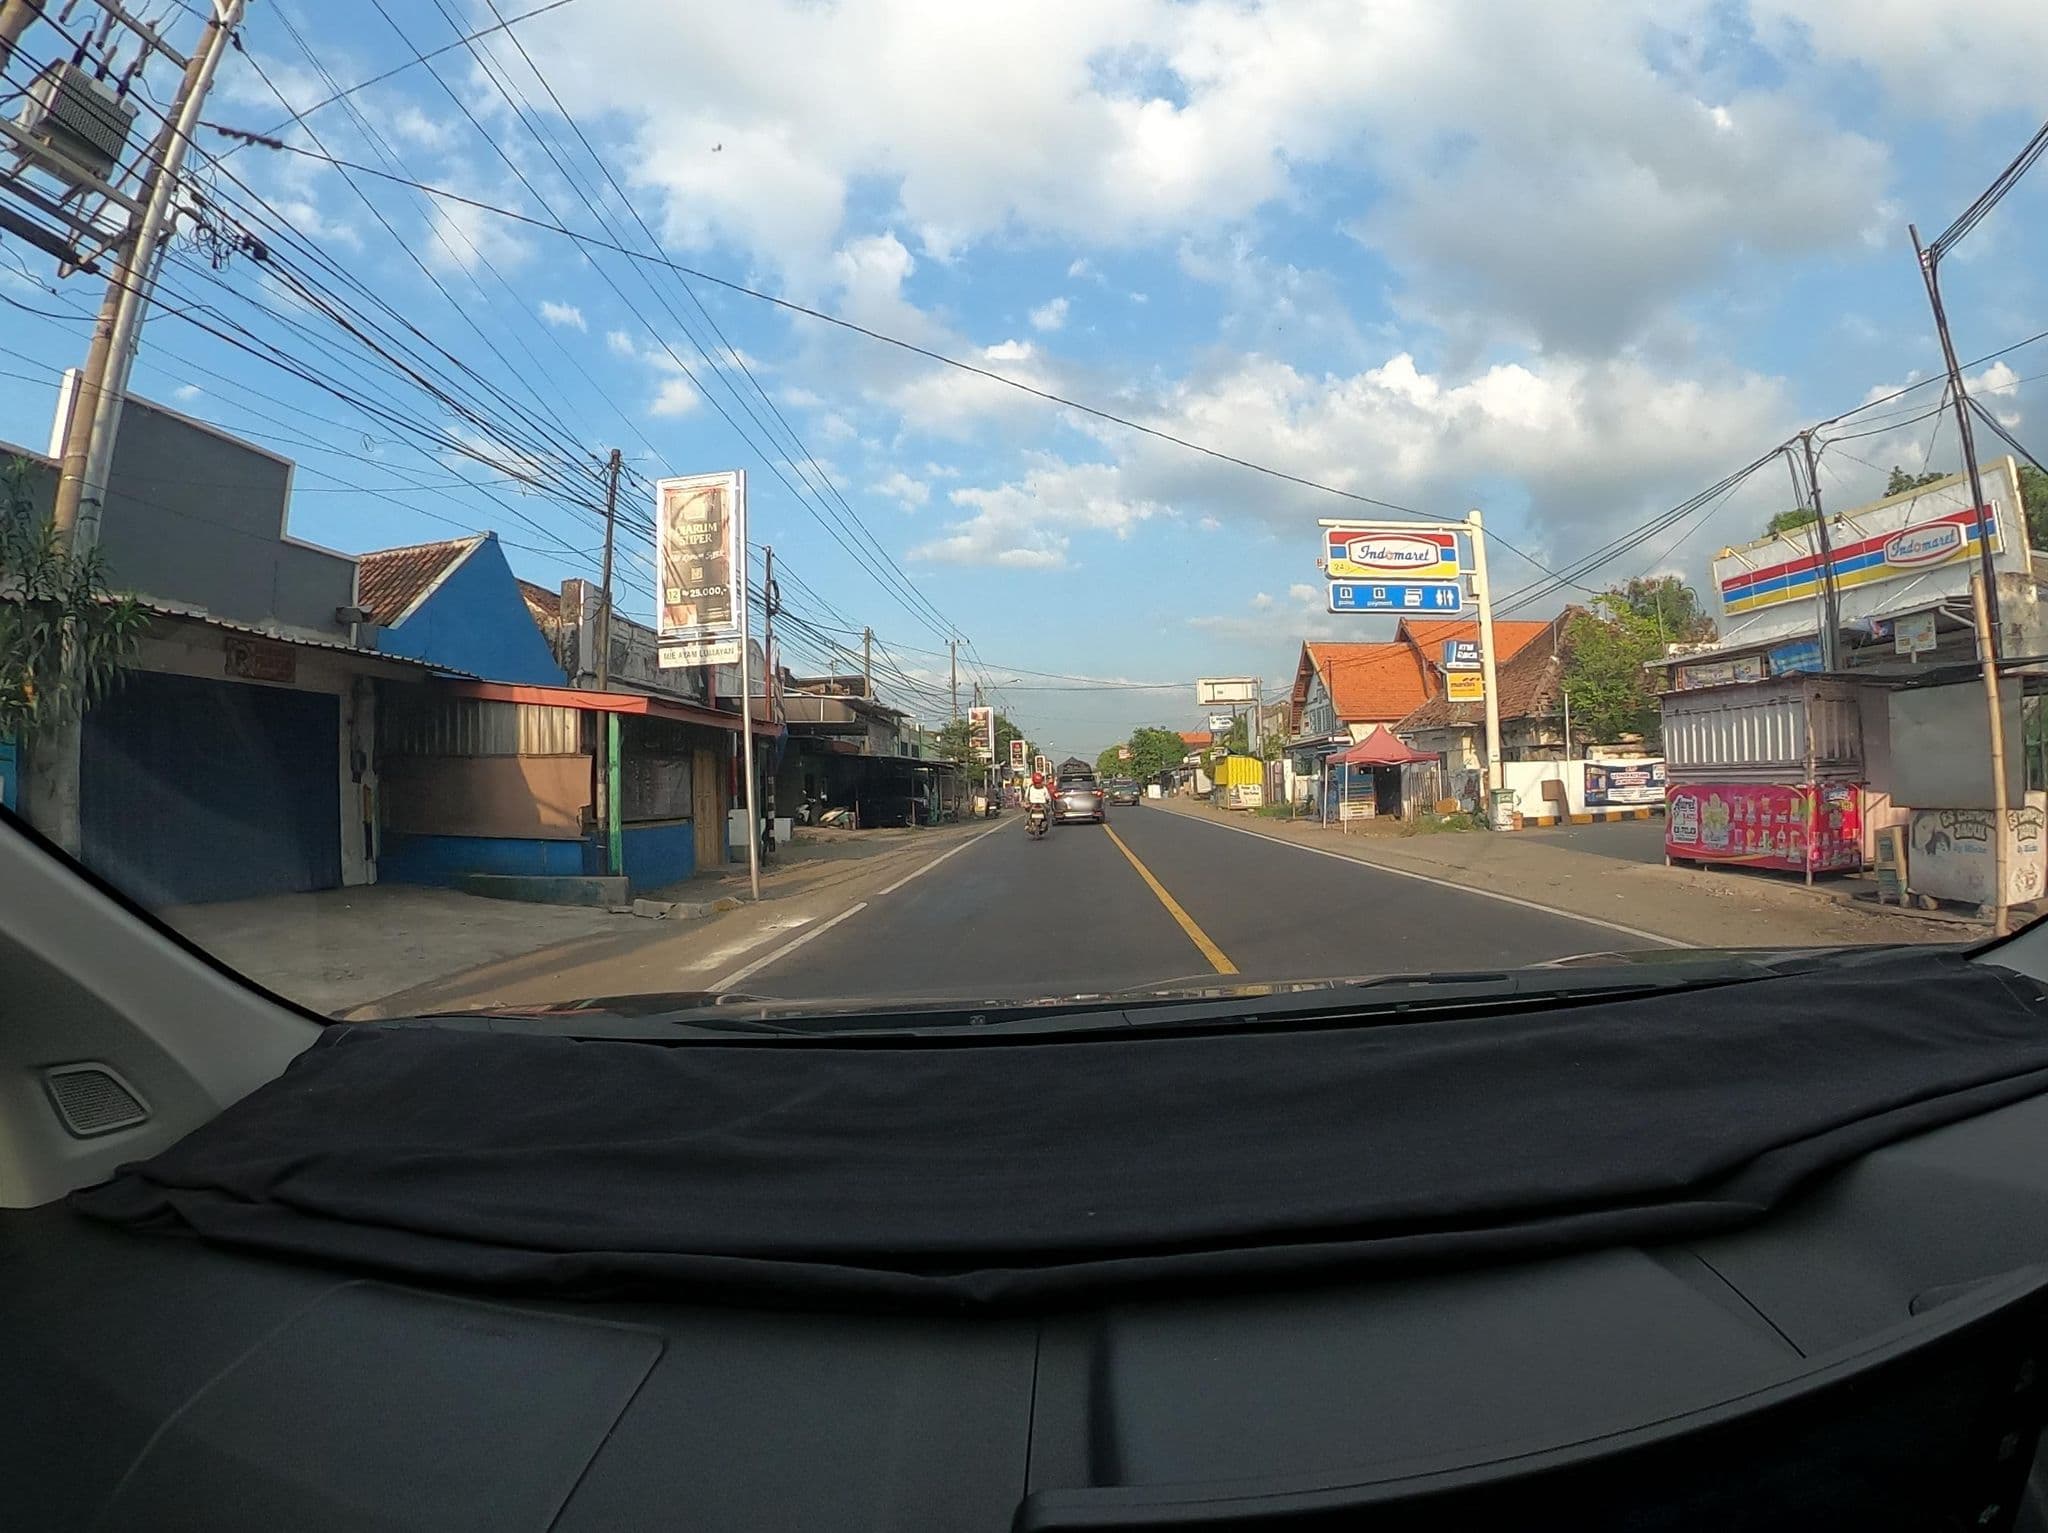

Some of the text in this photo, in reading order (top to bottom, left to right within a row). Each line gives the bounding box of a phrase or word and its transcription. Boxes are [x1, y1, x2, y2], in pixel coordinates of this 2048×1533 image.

[679, 534, 713, 546] SUPER
[1890, 530, 1955, 557] Indomaret
[1358, 545, 1429, 561] Indomaret
